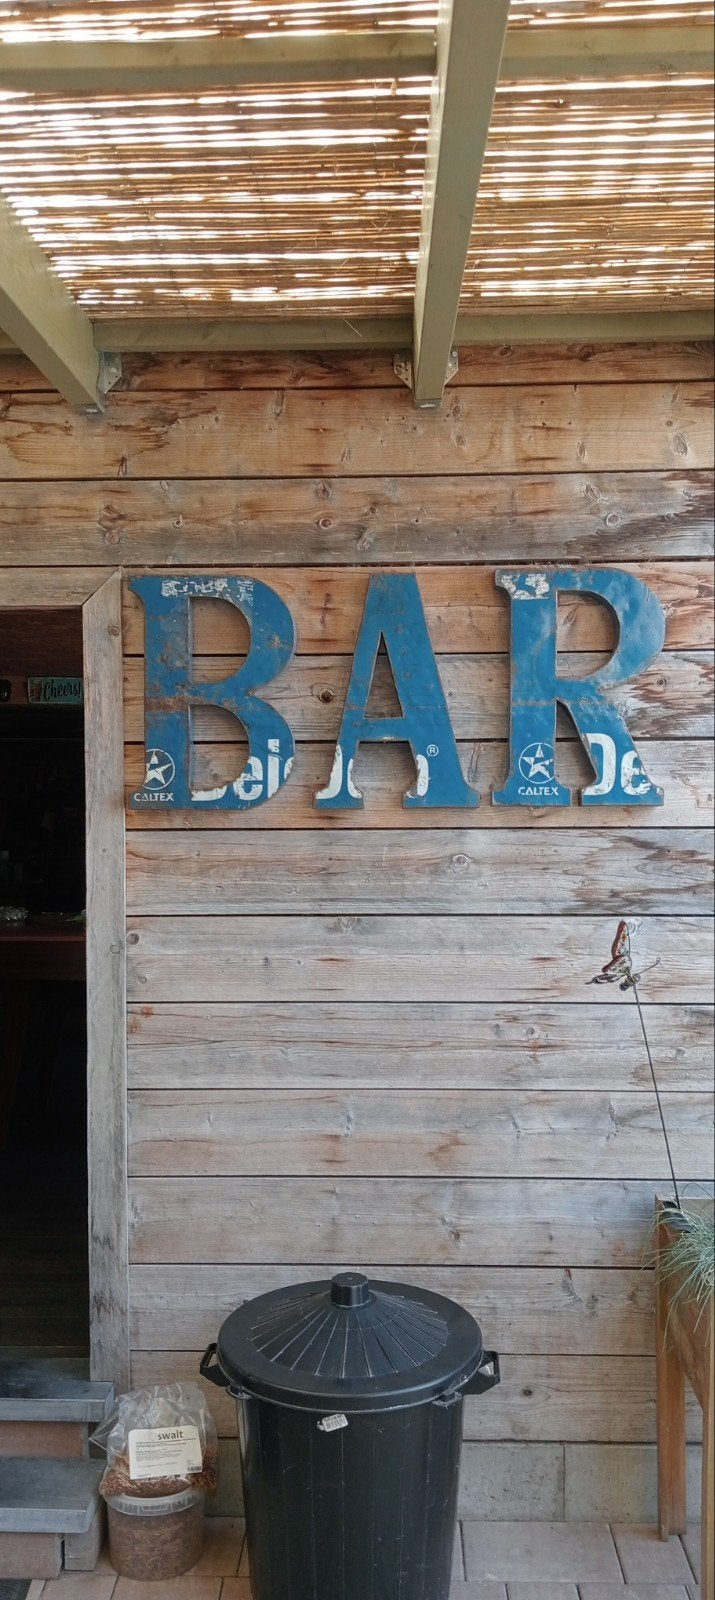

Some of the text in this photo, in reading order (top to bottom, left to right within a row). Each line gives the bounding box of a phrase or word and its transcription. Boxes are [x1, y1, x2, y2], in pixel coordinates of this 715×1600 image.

[44, 679, 81, 701] Cheers!
[128, 568, 666, 809] BAR
[133, 792, 175, 802] CALTEX
[517, 786, 559, 797] CALTEX
[157, 1429, 184, 1441] swalt
